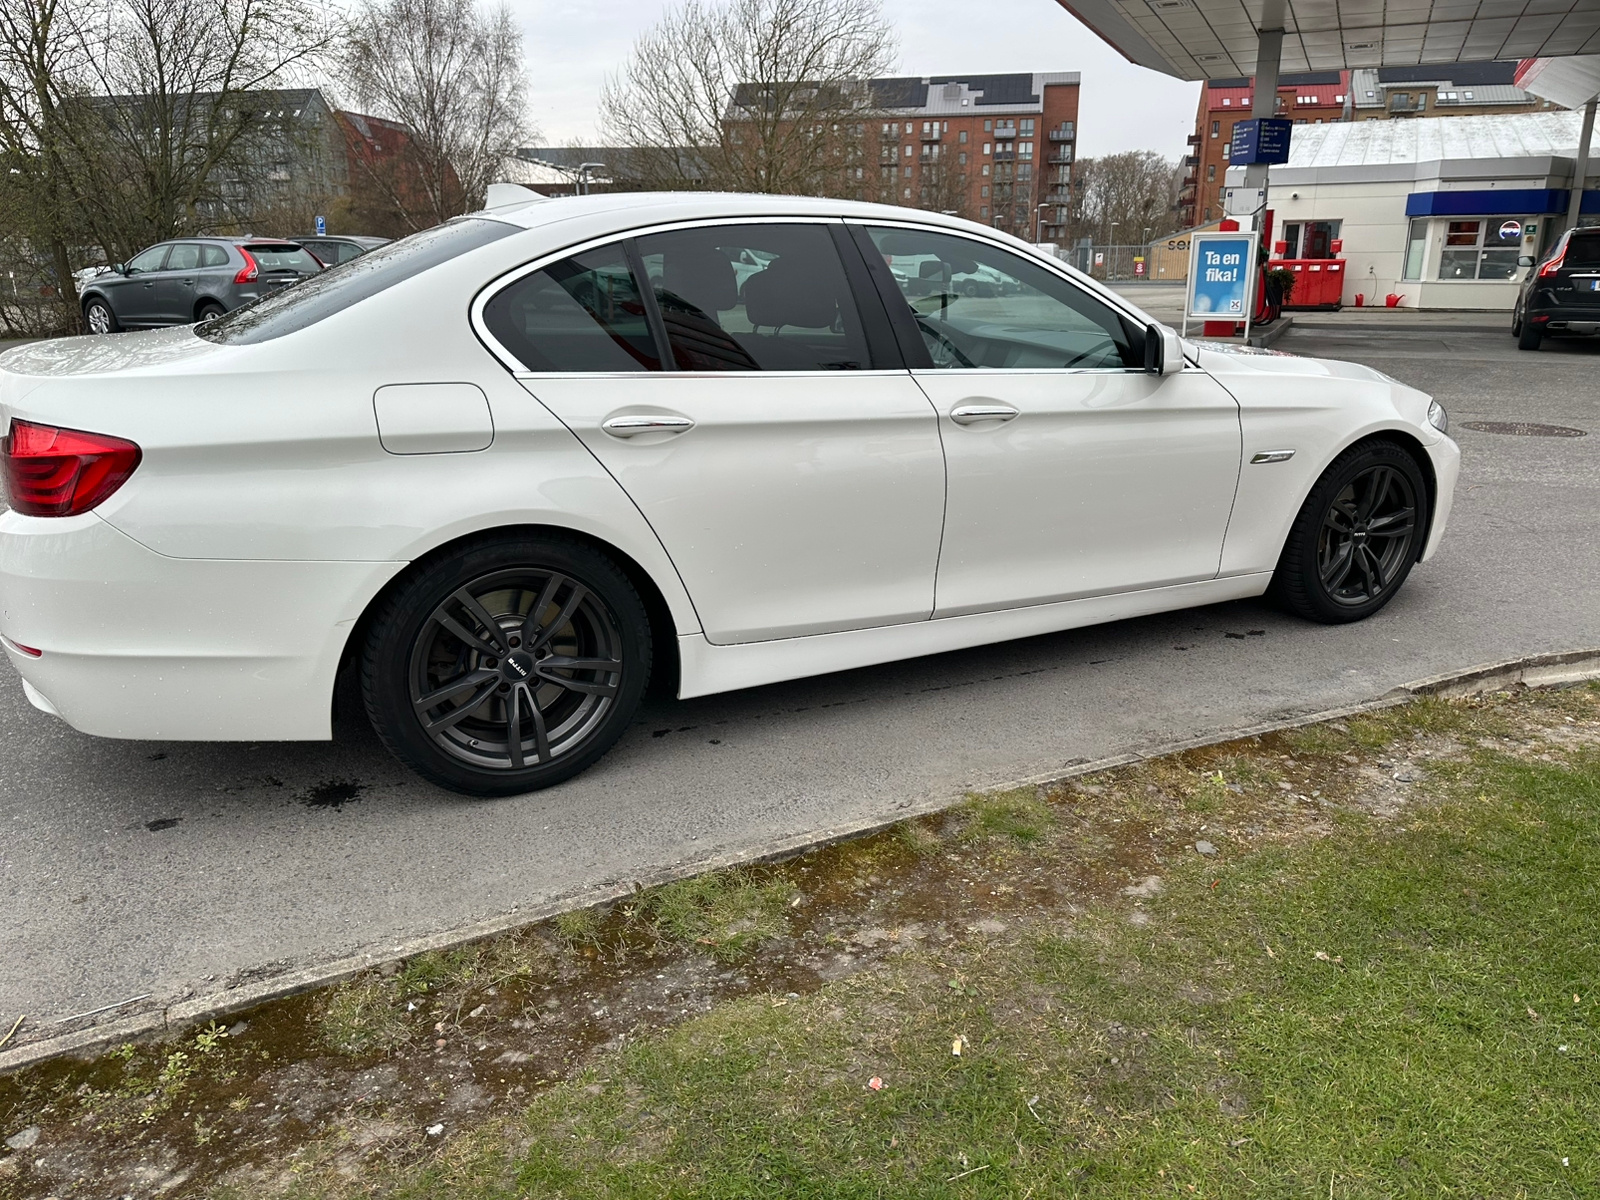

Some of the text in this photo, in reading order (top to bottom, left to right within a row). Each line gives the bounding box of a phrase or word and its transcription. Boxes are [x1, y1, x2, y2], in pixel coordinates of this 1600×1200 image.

[1205, 251, 1240, 265] Ta en
[1205, 268, 1238, 282] fika!
